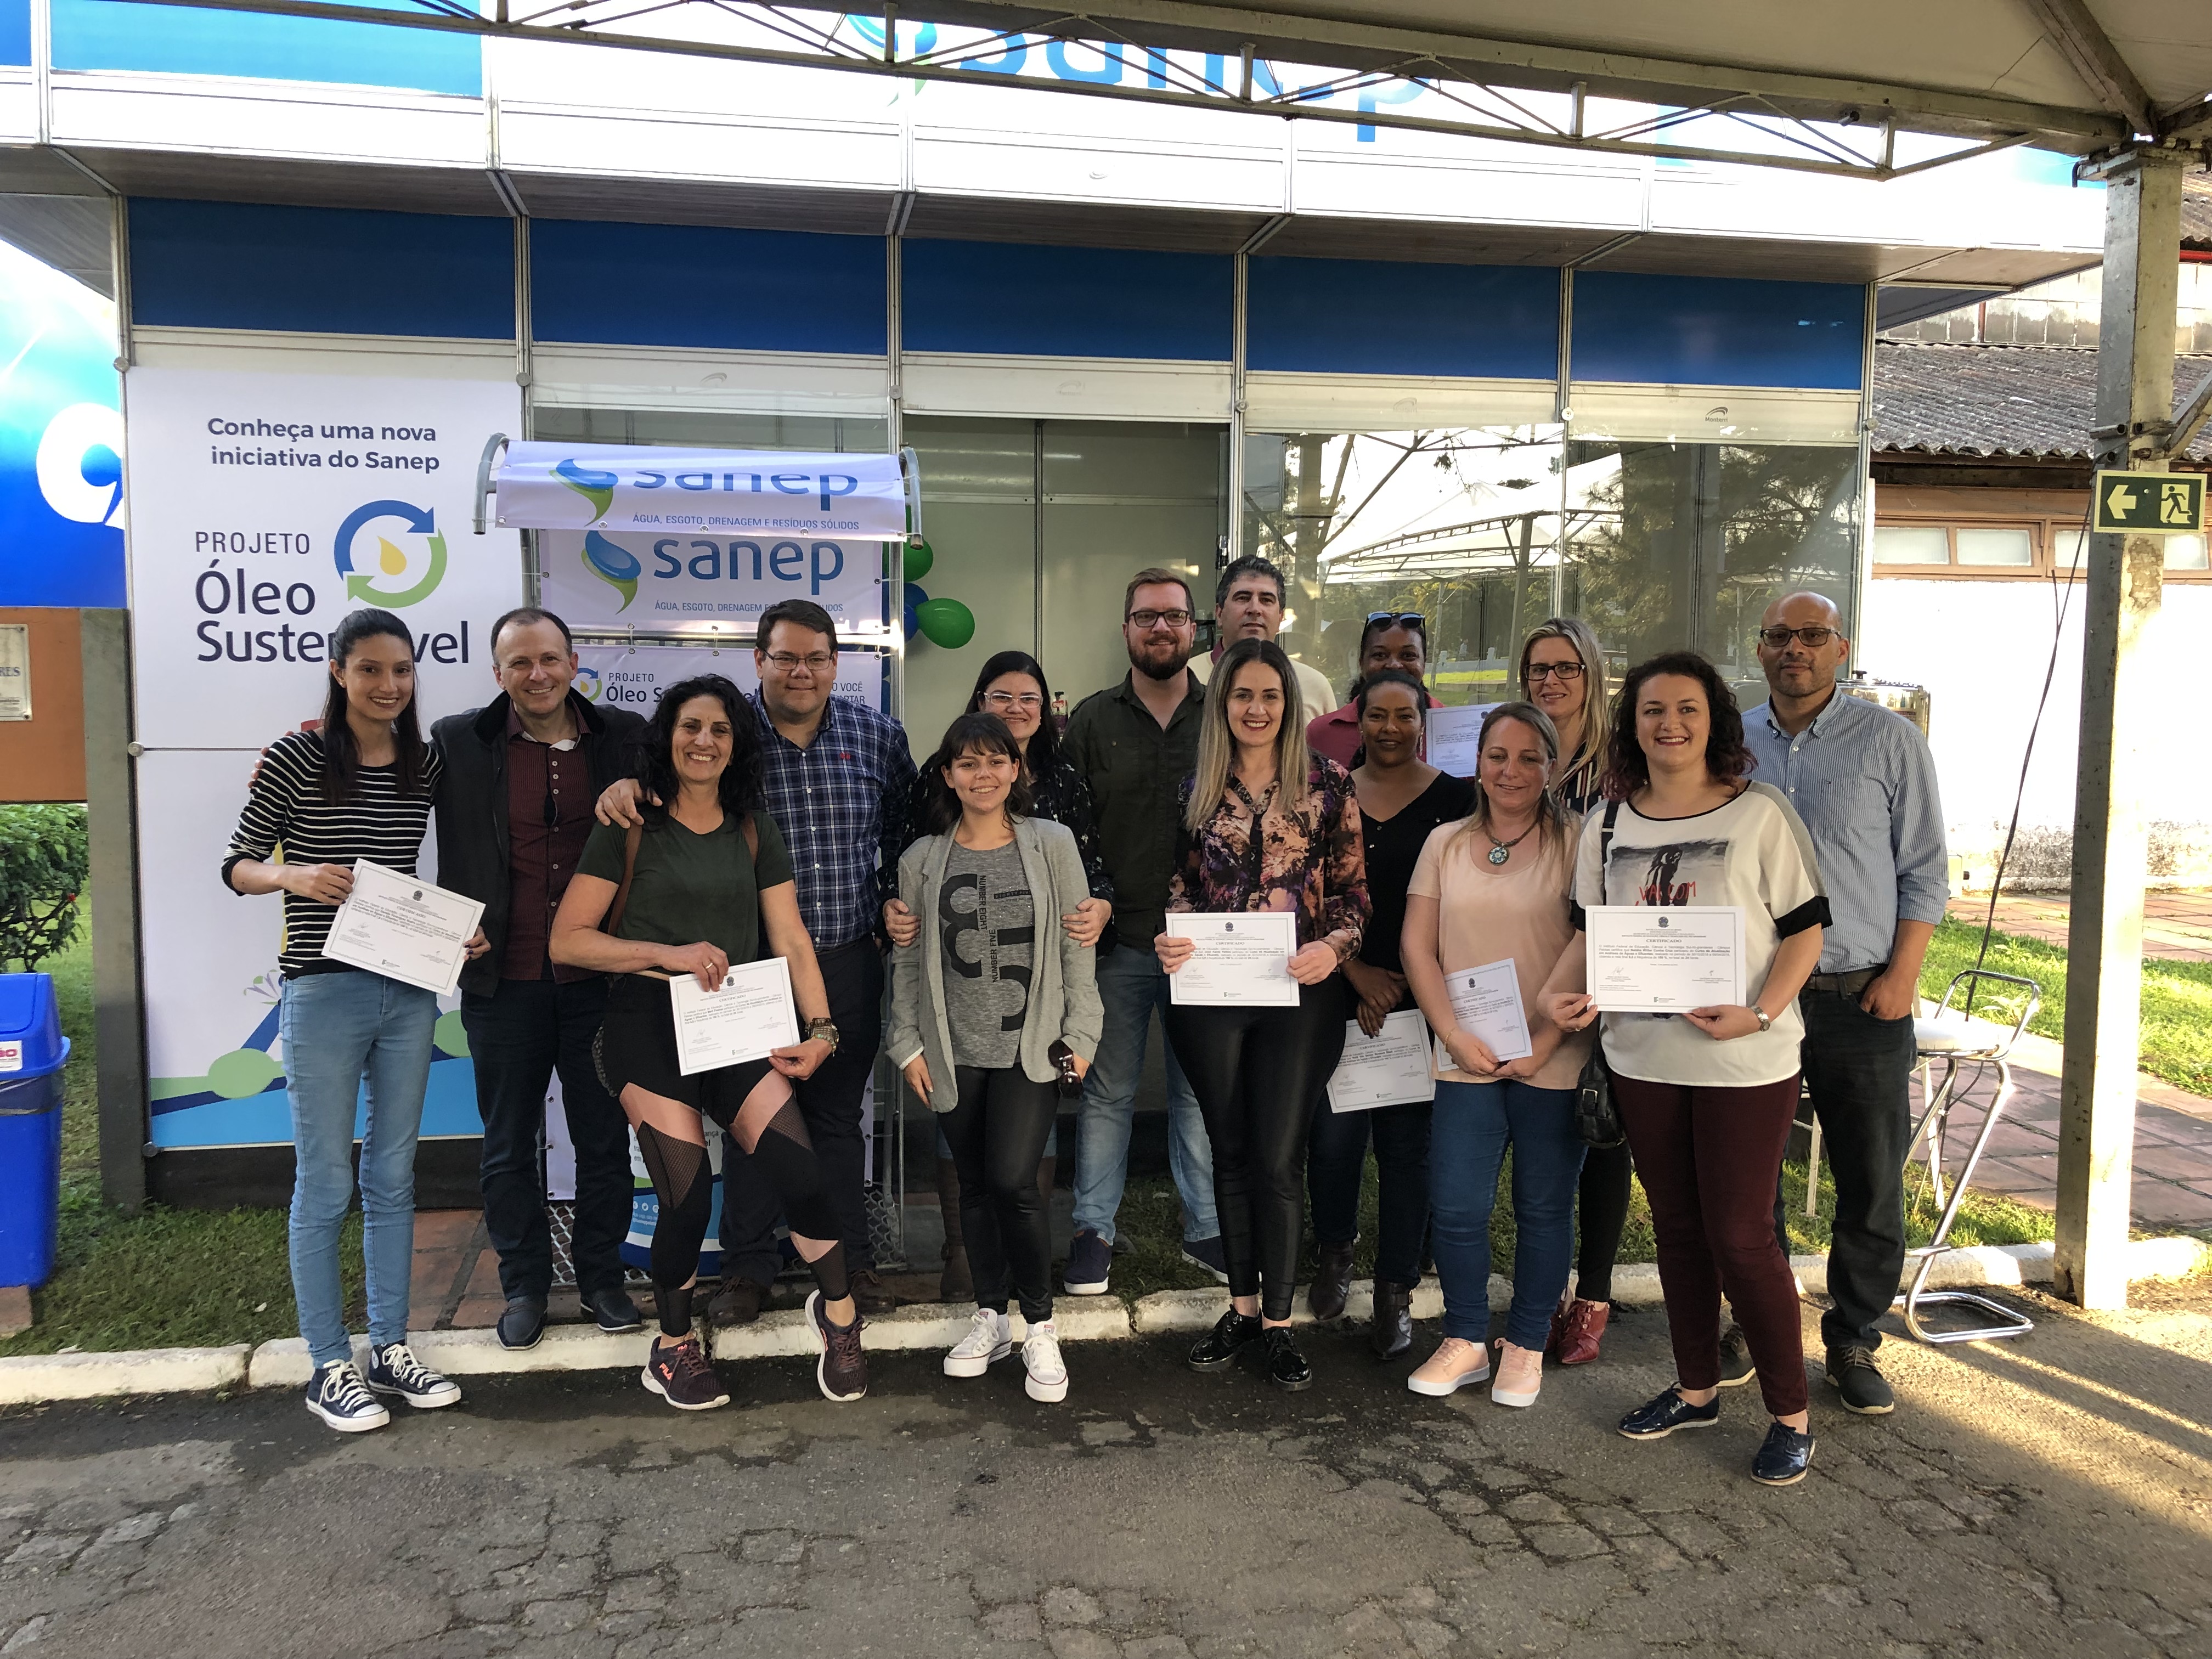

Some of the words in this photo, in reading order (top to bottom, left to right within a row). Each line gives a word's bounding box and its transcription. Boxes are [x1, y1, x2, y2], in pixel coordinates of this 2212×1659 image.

[207, 417, 314, 442] Conheça
[321, 425, 374, 439] uma
[382, 426, 436, 441] nova
[211, 445, 322, 467] iniciativa
[328, 450, 359, 469] do
[365, 451, 440, 474] Sanep
[633, 470, 858, 511] sanep
[633, 512, 663, 524] ÁGUA,
[708, 516, 762, 526] DRENAGEM
[772, 517, 819, 529] RESÍDUOS
[820, 518, 859, 530] SÓLIDOS
[195, 532, 311, 554] PROJETO
[653, 539, 844, 595] sanep
[195, 558, 315, 615] Óleo
[654, 600, 680, 612] ÁGUA,
[682, 602, 715, 612] ESGOTO,
[718, 603, 762, 612] DRENAGEM
[197, 620, 469, 664] Sustevel
[608, 673, 654, 682] PROJETO
[840, 681, 863, 692] VOCÊ
[606, 682, 647, 703] Óleo
[978, 875, 986, 909] NUMBER
[979, 910, 988, 930] EIGHT
[990, 949, 998, 983] NUMBER
